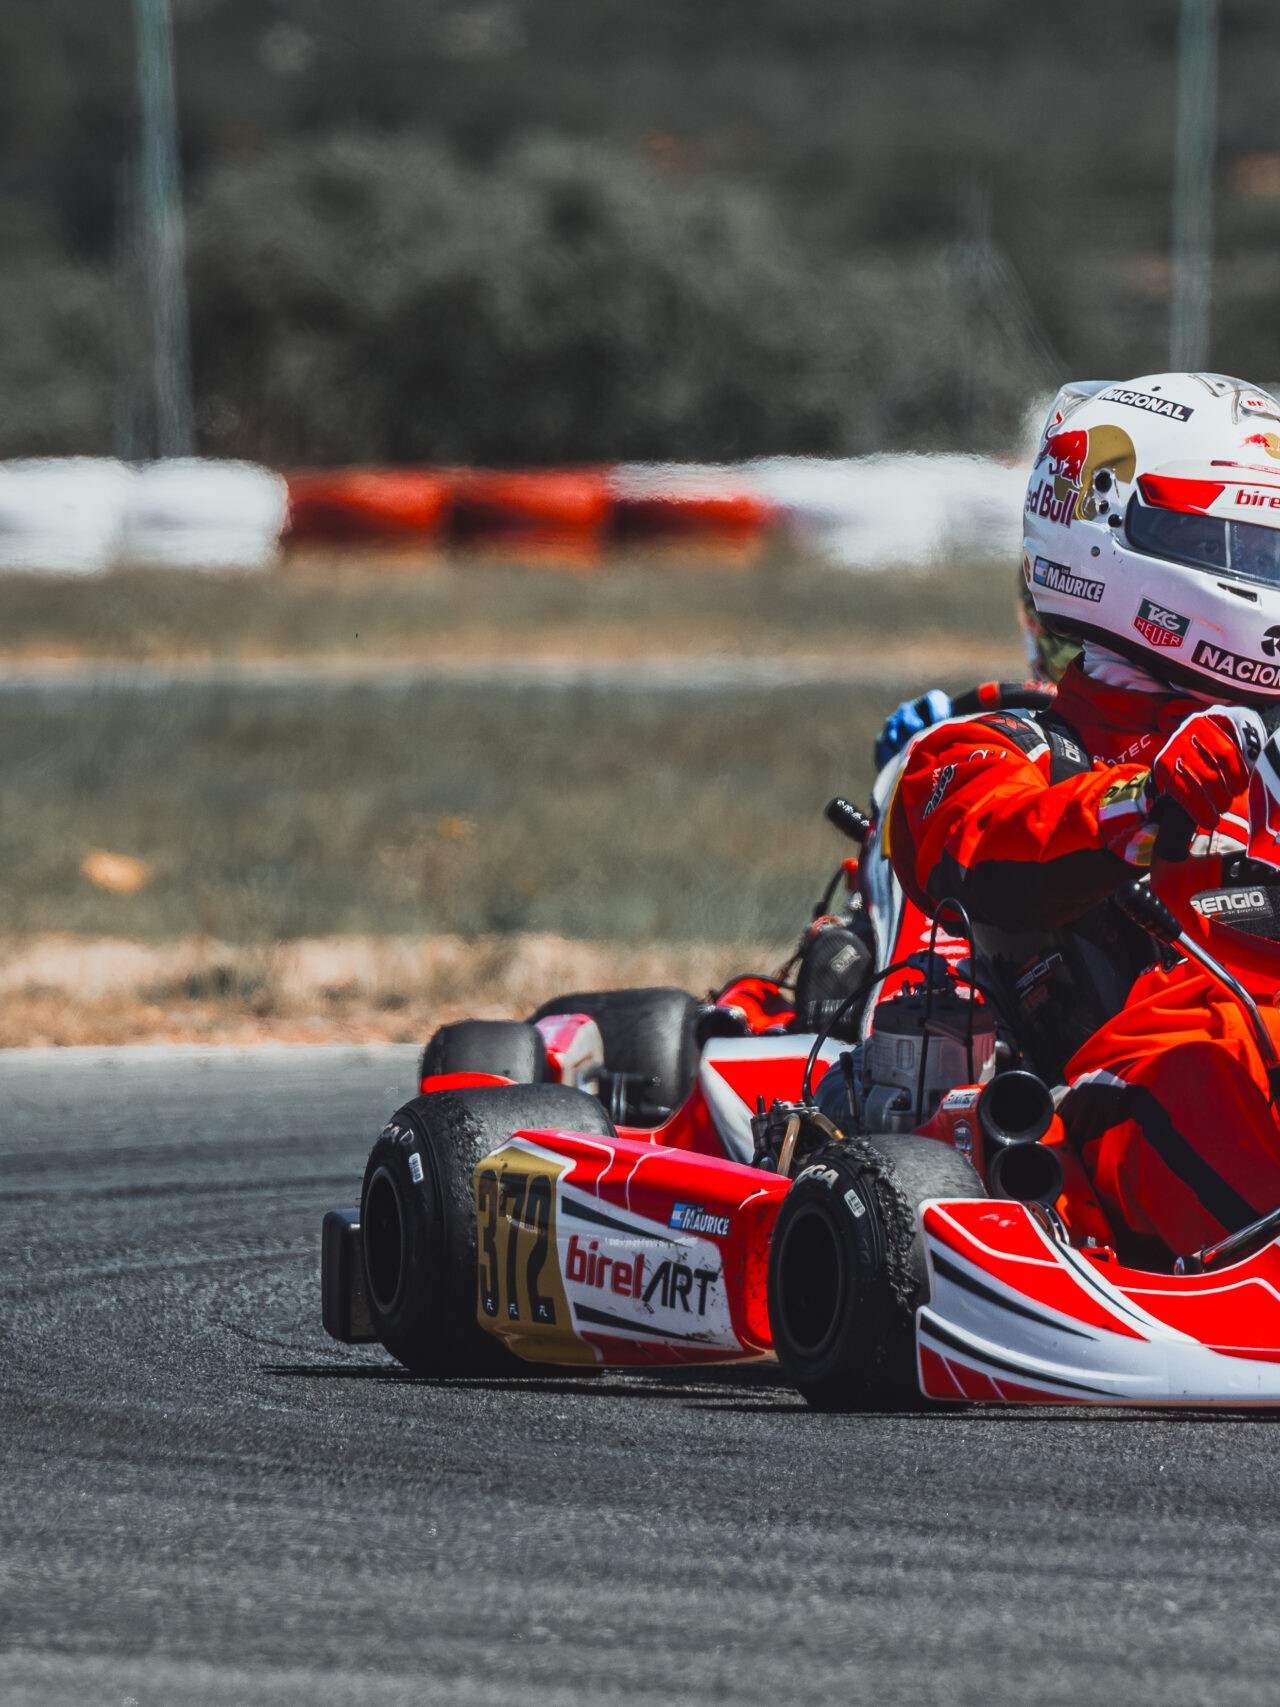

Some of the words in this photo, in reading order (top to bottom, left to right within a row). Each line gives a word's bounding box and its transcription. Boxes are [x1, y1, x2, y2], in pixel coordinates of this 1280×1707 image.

[1100, 390, 1185, 420] NACIONAL
[1039, 483, 1079, 528] Bull
[1046, 566, 1103, 601] MAURICE
[1136, 619, 1180, 646] HEUER
[1147, 603, 1180, 631] TAG
[683, 1208, 730, 1235] MAURICE
[478, 1169, 557, 1325] 372
[566, 1235, 718, 1315] birelART
